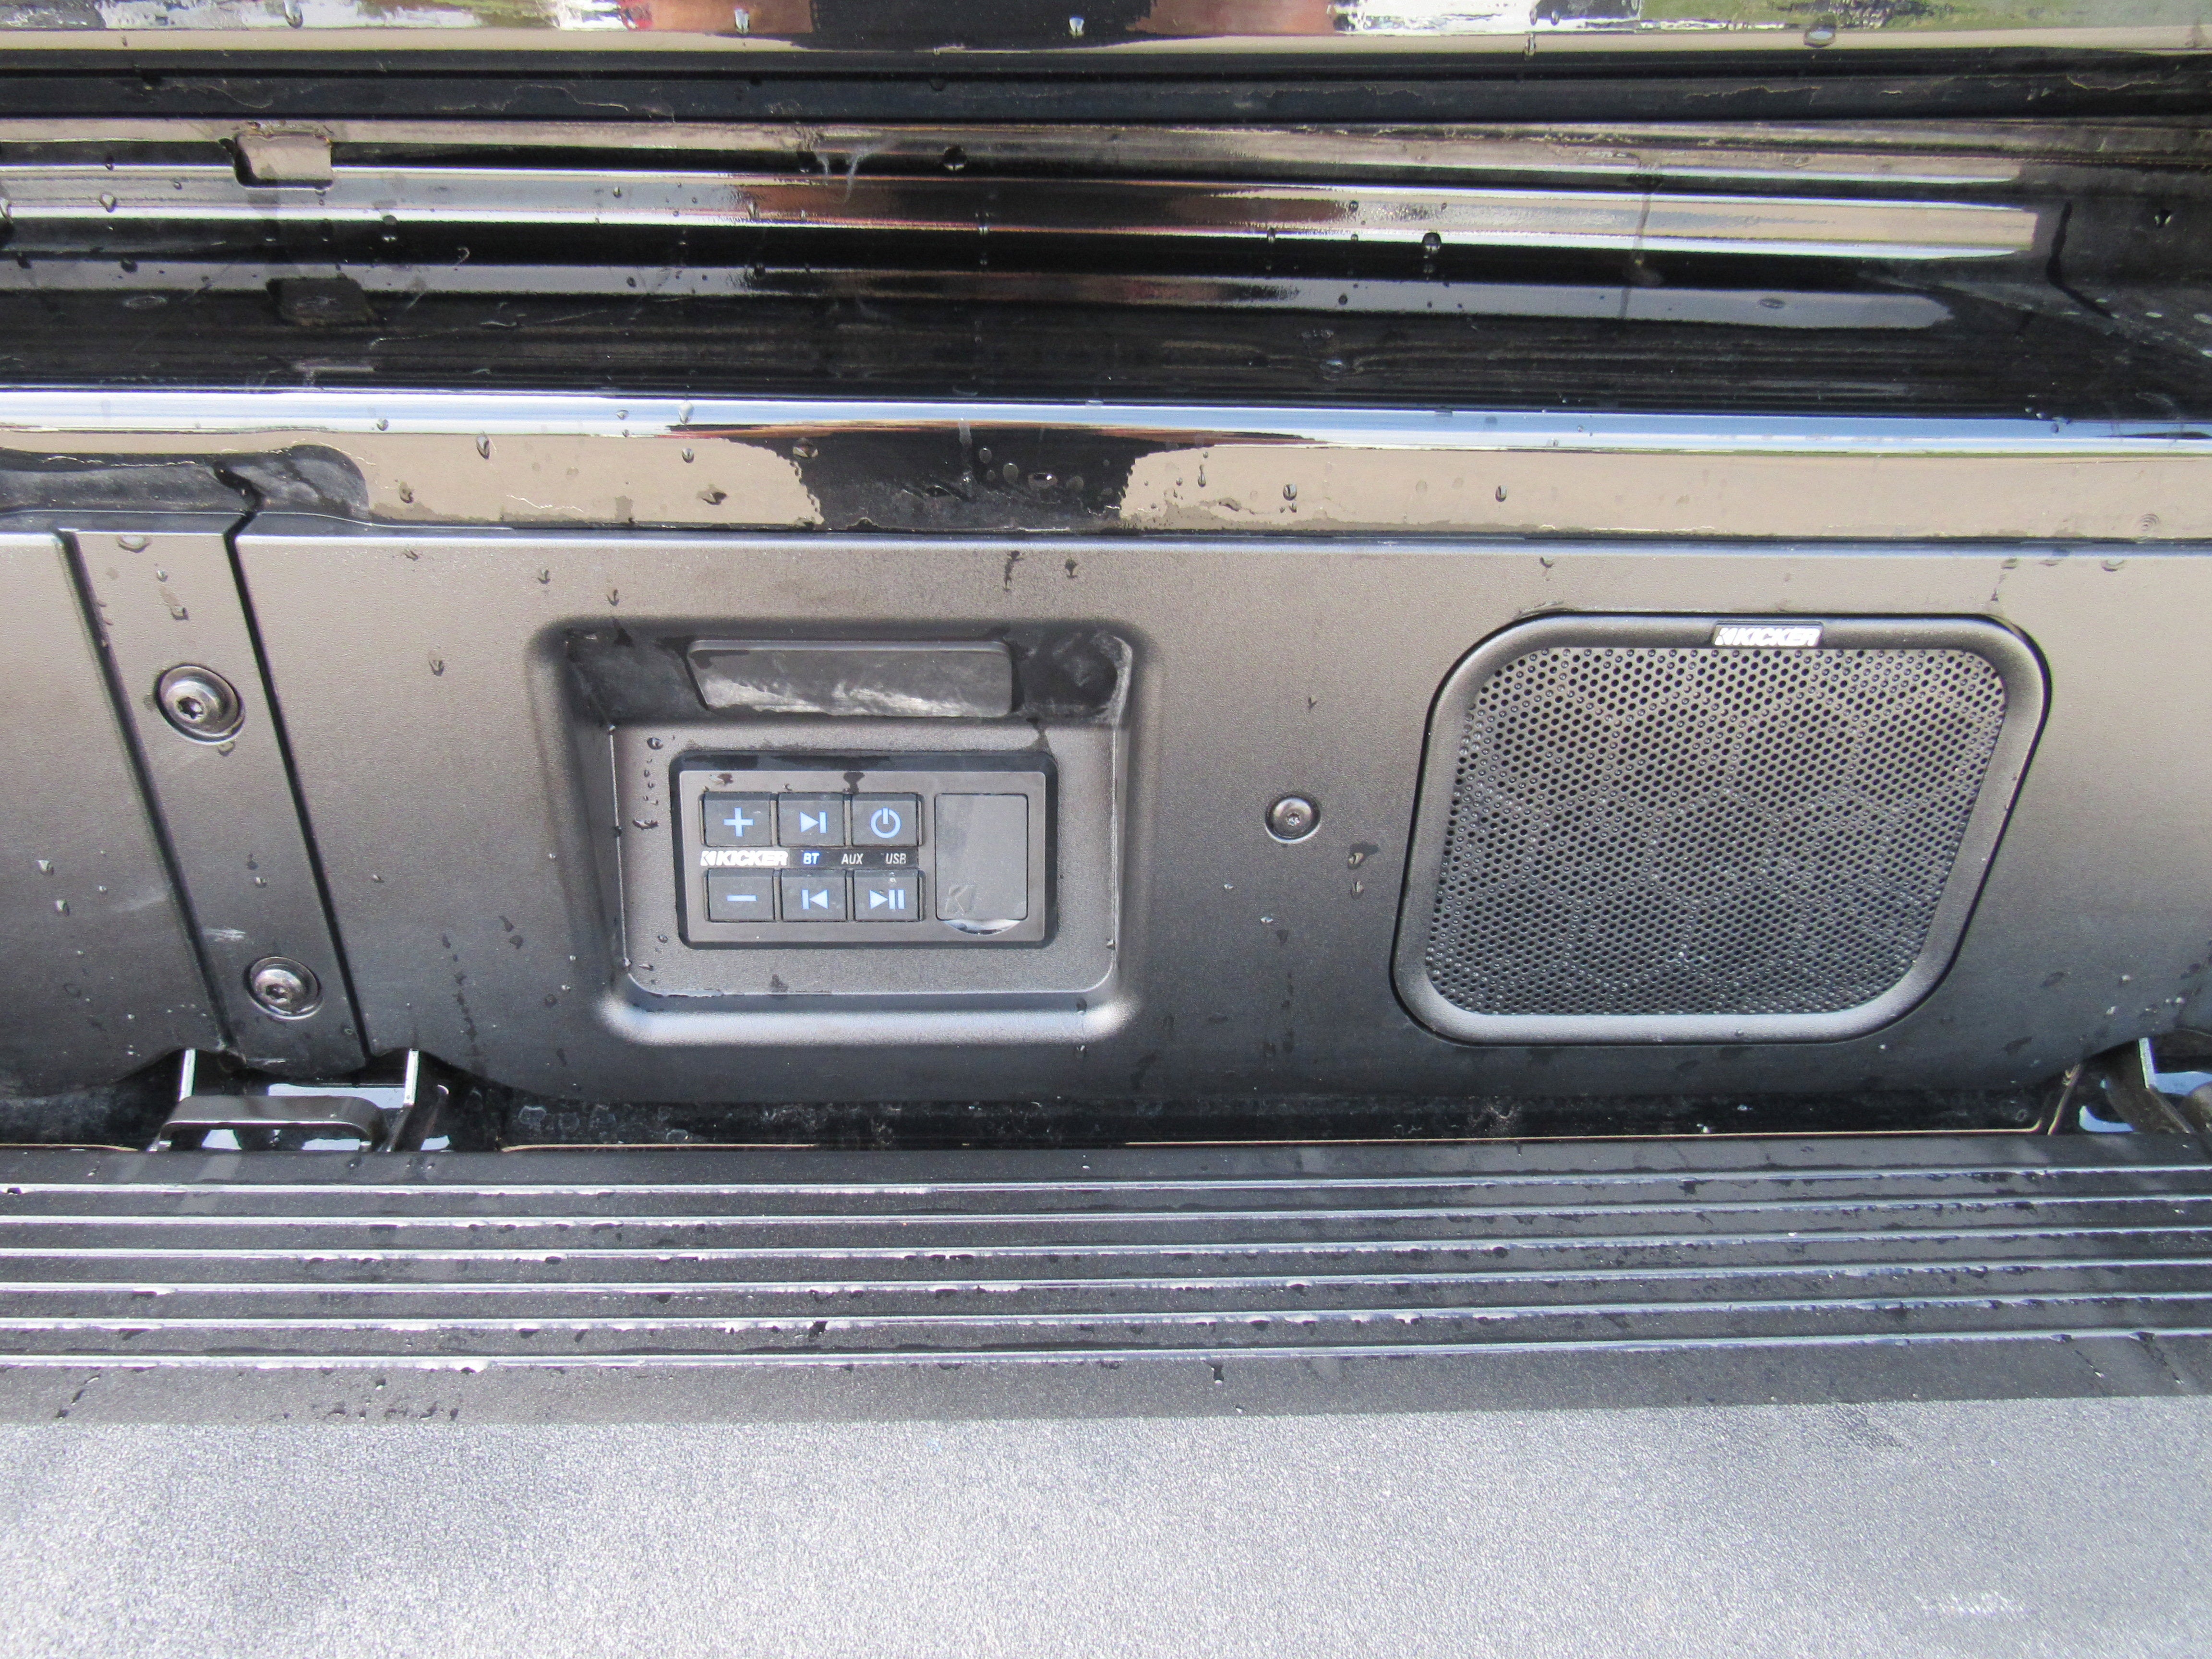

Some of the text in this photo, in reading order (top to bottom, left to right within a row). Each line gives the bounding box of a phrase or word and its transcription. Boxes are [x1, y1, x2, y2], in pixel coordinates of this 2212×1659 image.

[1732, 627, 1820, 646] KICKER
[716, 850, 789, 866] KICKER
[803, 852, 820, 865] BT
[841, 853, 864, 865] AUX
[886, 853, 906, 864] USB
